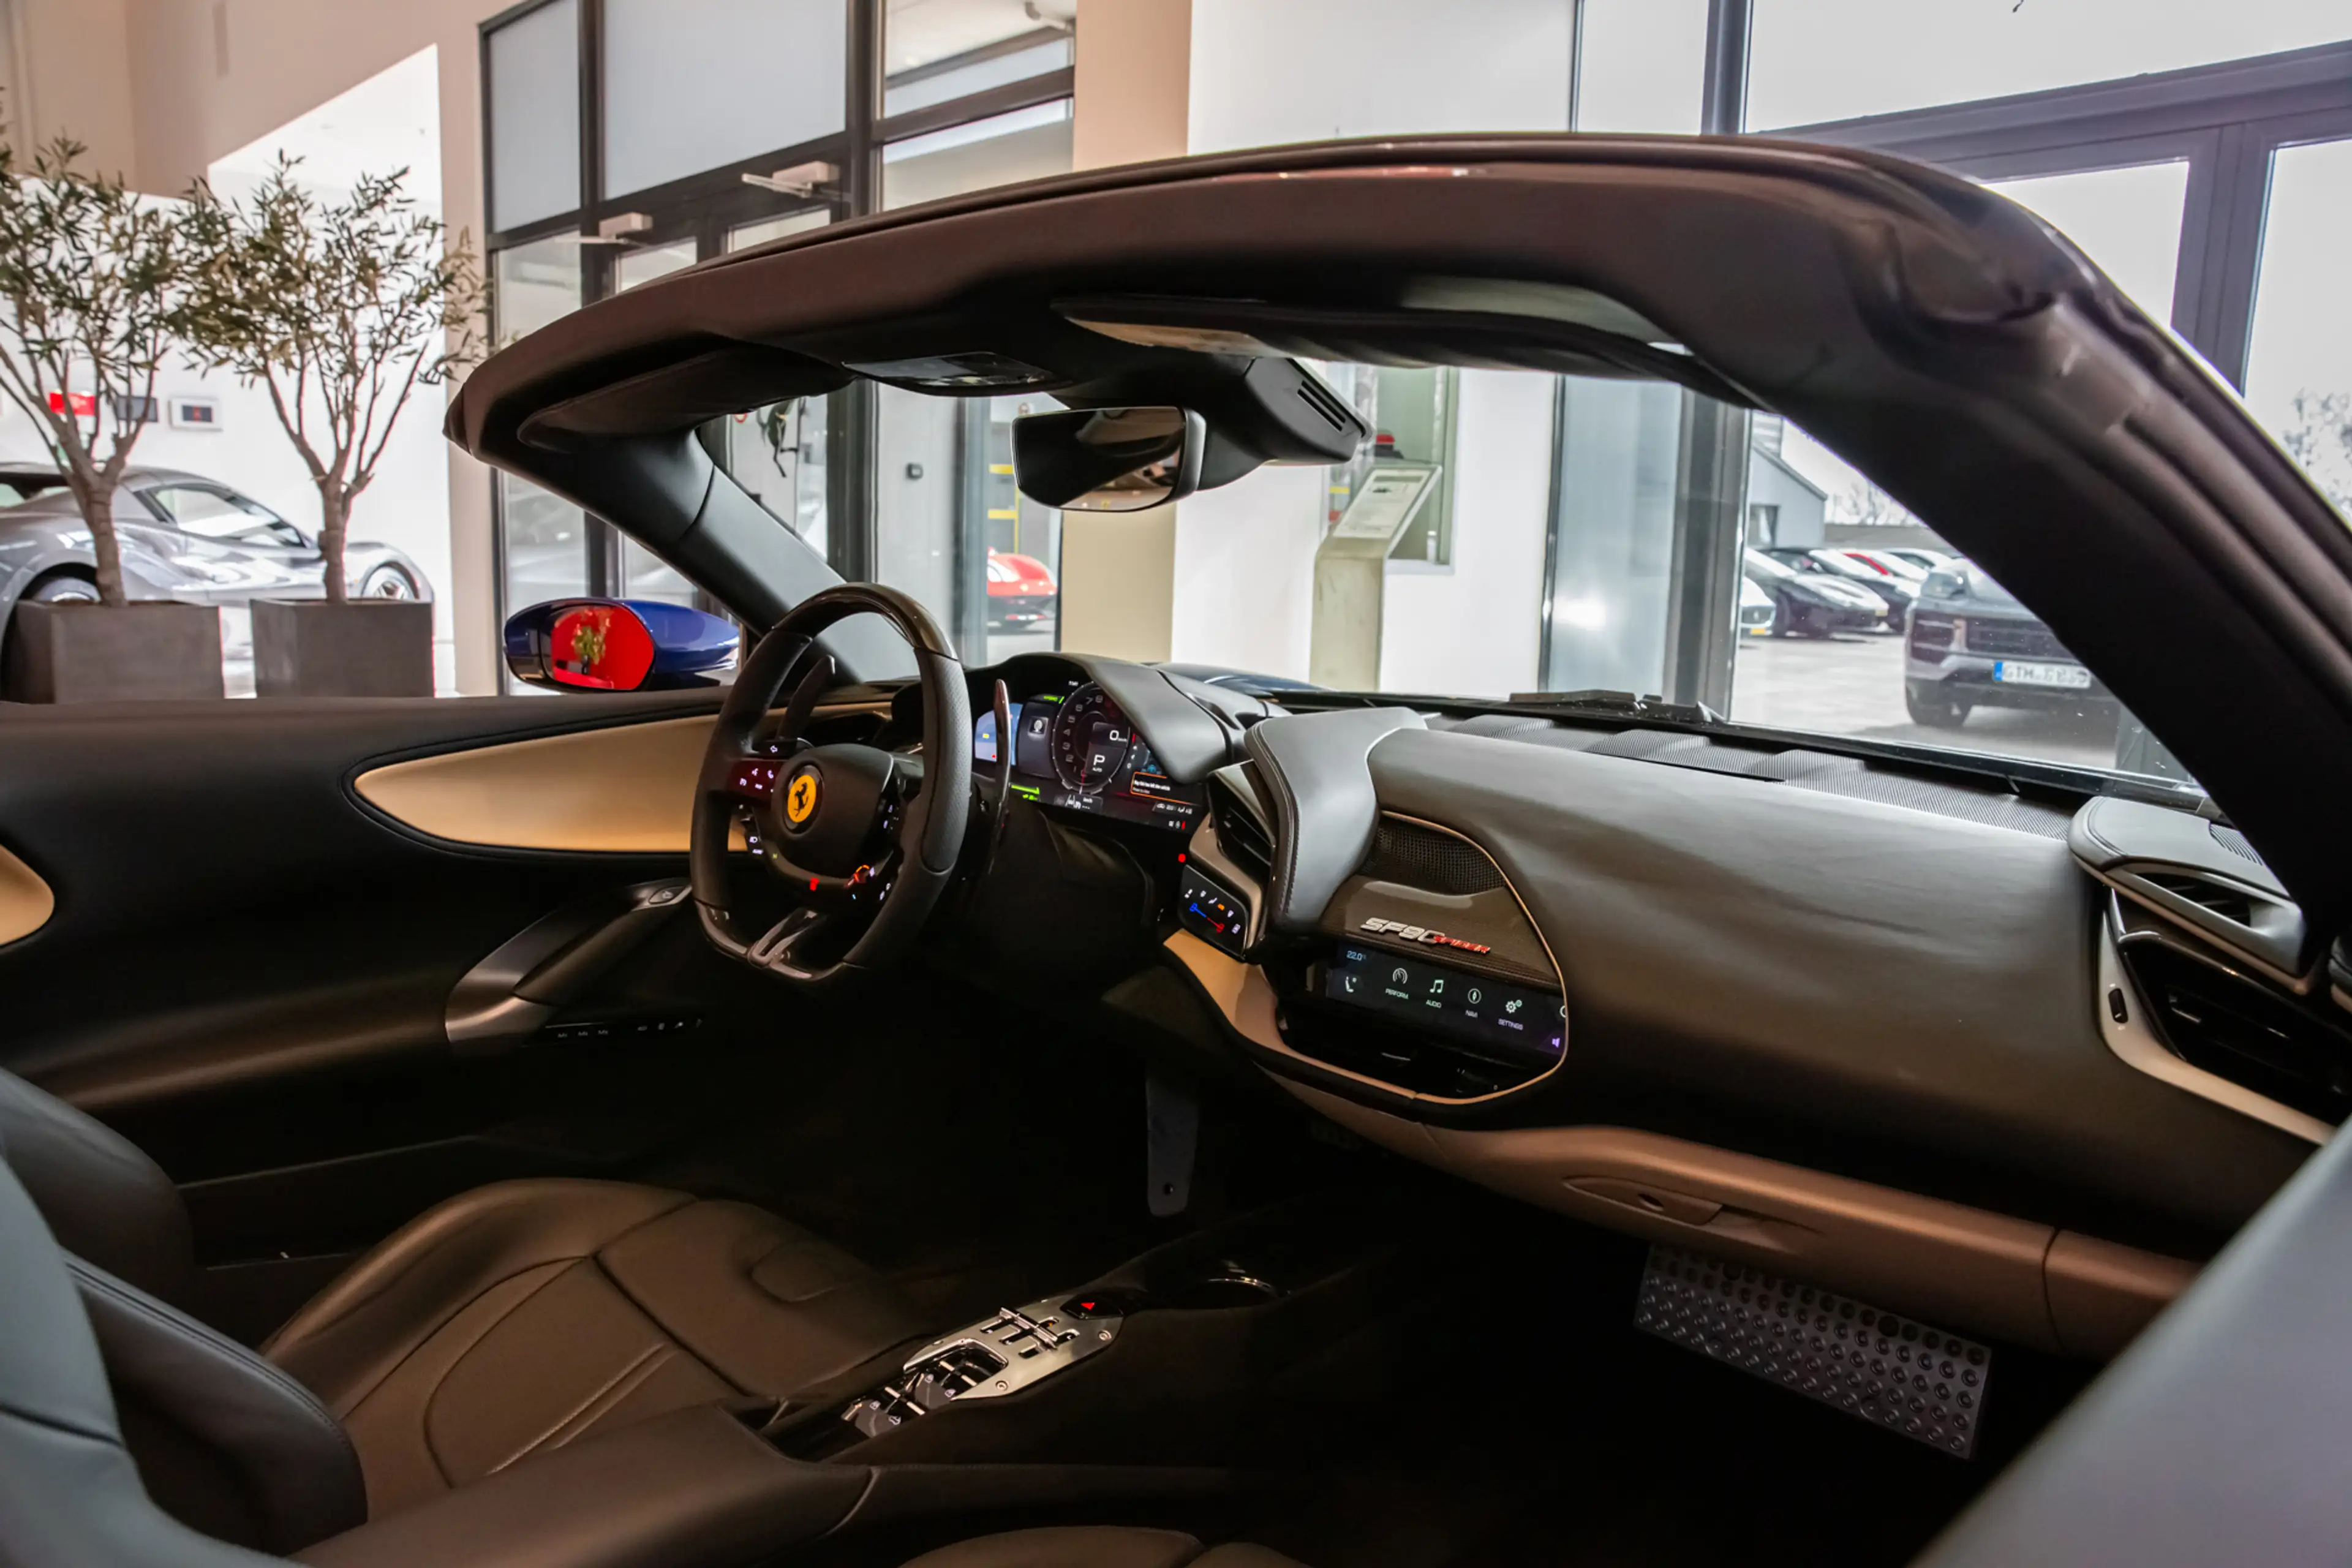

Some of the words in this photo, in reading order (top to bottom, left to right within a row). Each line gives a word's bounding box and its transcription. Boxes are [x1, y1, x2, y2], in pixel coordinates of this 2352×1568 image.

[1086, 696, 1093, 705] 7
[1109, 729, 1120, 741] 0
[1062, 742, 1071, 751] 3
[1066, 754, 1074, 763] 2
[1093, 754, 1106, 766] P
[1426, 999, 1442, 1009] AUDIO
[1498, 1018, 1524, 1031] SETTINGS
